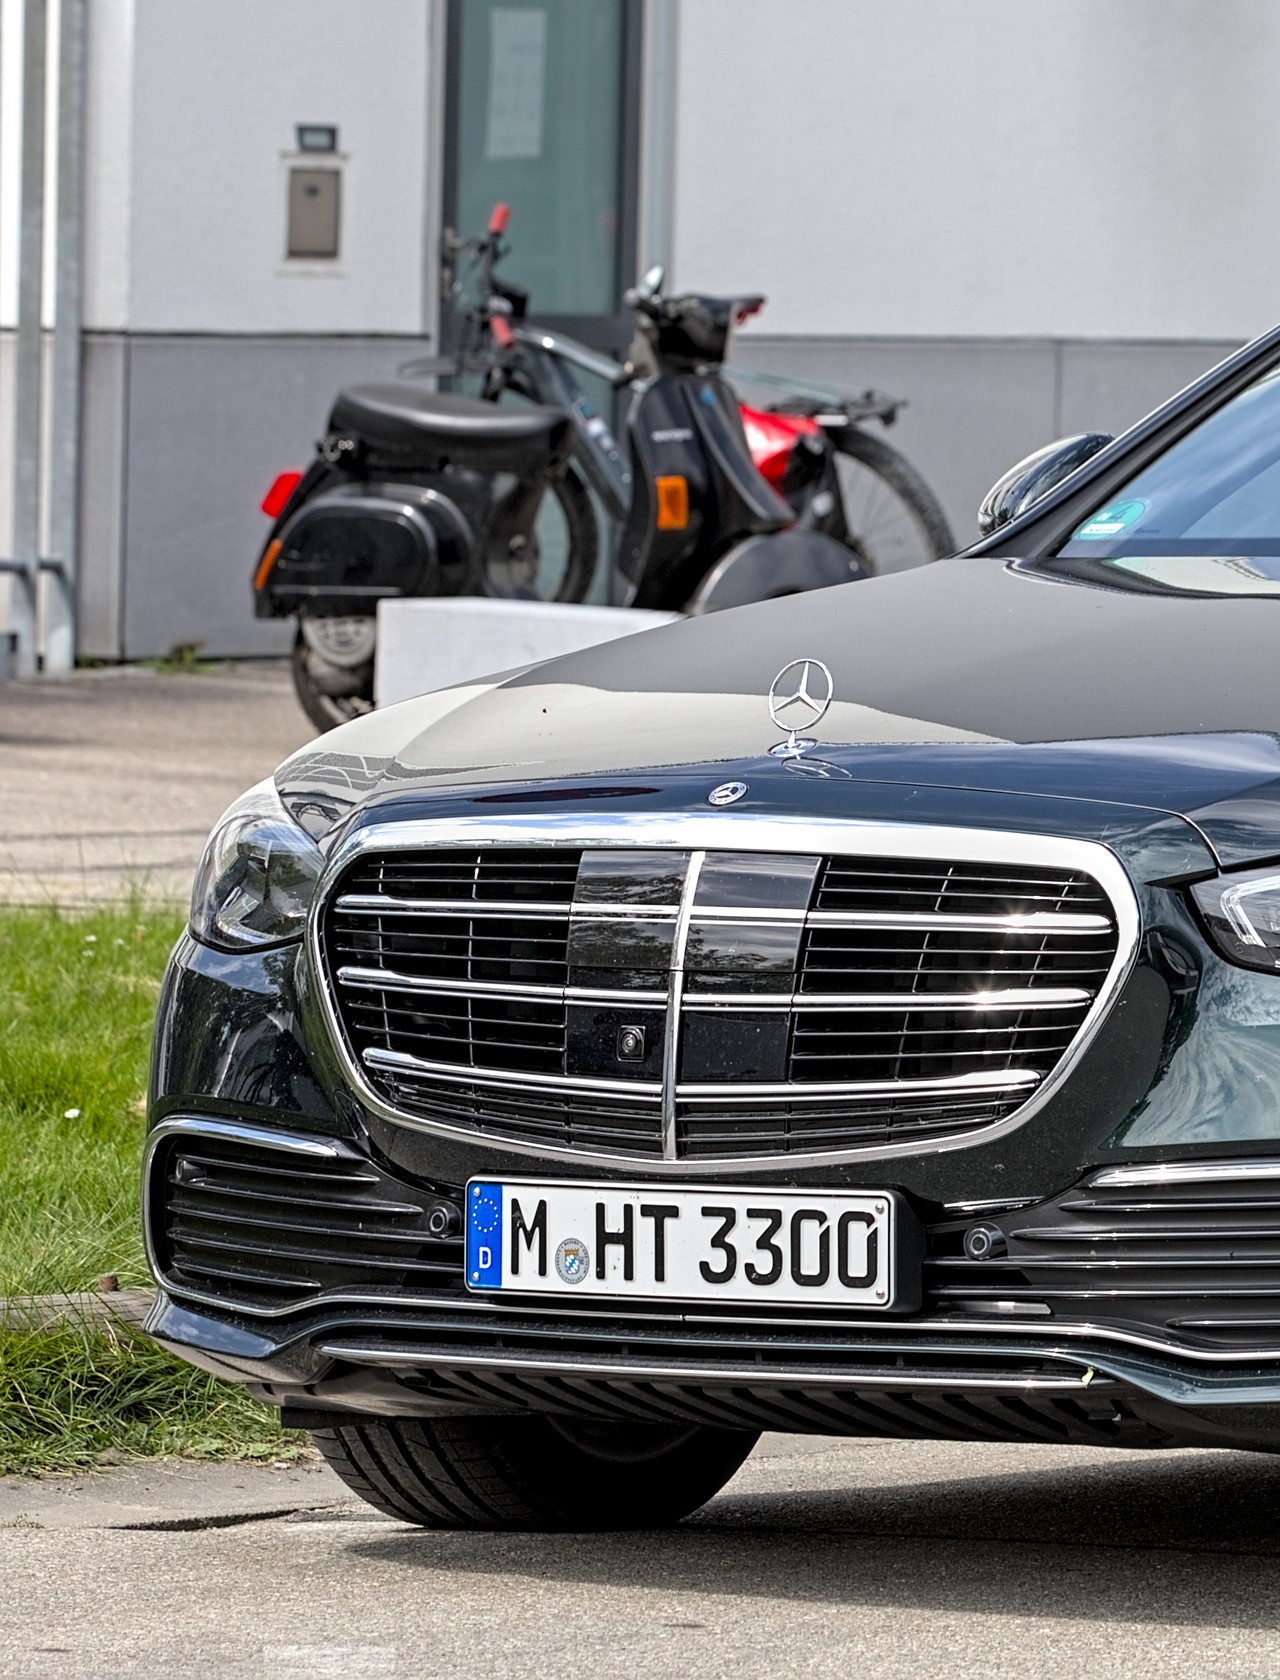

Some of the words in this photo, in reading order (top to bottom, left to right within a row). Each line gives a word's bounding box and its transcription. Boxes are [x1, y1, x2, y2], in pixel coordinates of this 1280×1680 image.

[478, 1246, 492, 1270] D
[510, 1198, 548, 1277] M
[595, 1202, 680, 1282] HT
[698, 1205, 879, 1288] 3300
